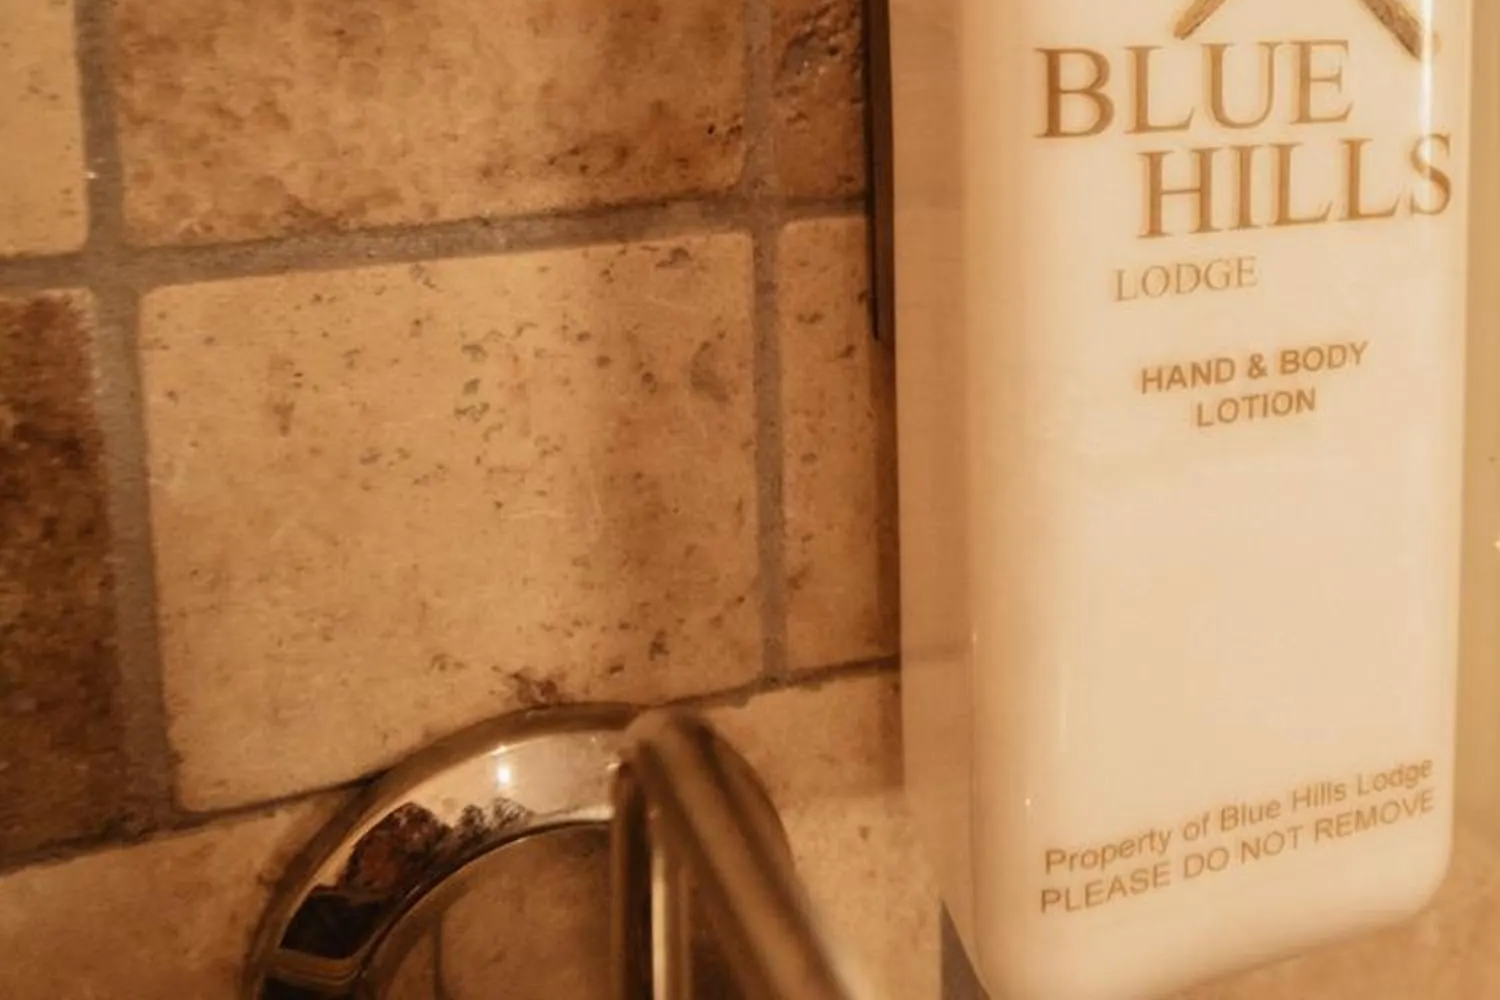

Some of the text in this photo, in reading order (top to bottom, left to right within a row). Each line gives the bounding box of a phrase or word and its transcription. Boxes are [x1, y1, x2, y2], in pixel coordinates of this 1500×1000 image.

[1033, 38, 1353, 139] BLUE
[1137, 131, 1452, 239] HILLS
[1114, 255, 1258, 302] LODGE
[1141, 341, 1369, 393] HAND & BODY
[1196, 388, 1317, 427] LOTION
[1040, 789, 1436, 915] PLEASE DO NOT REMOVE
[1044, 758, 1434, 875] Property of Blue Hills Lodge
